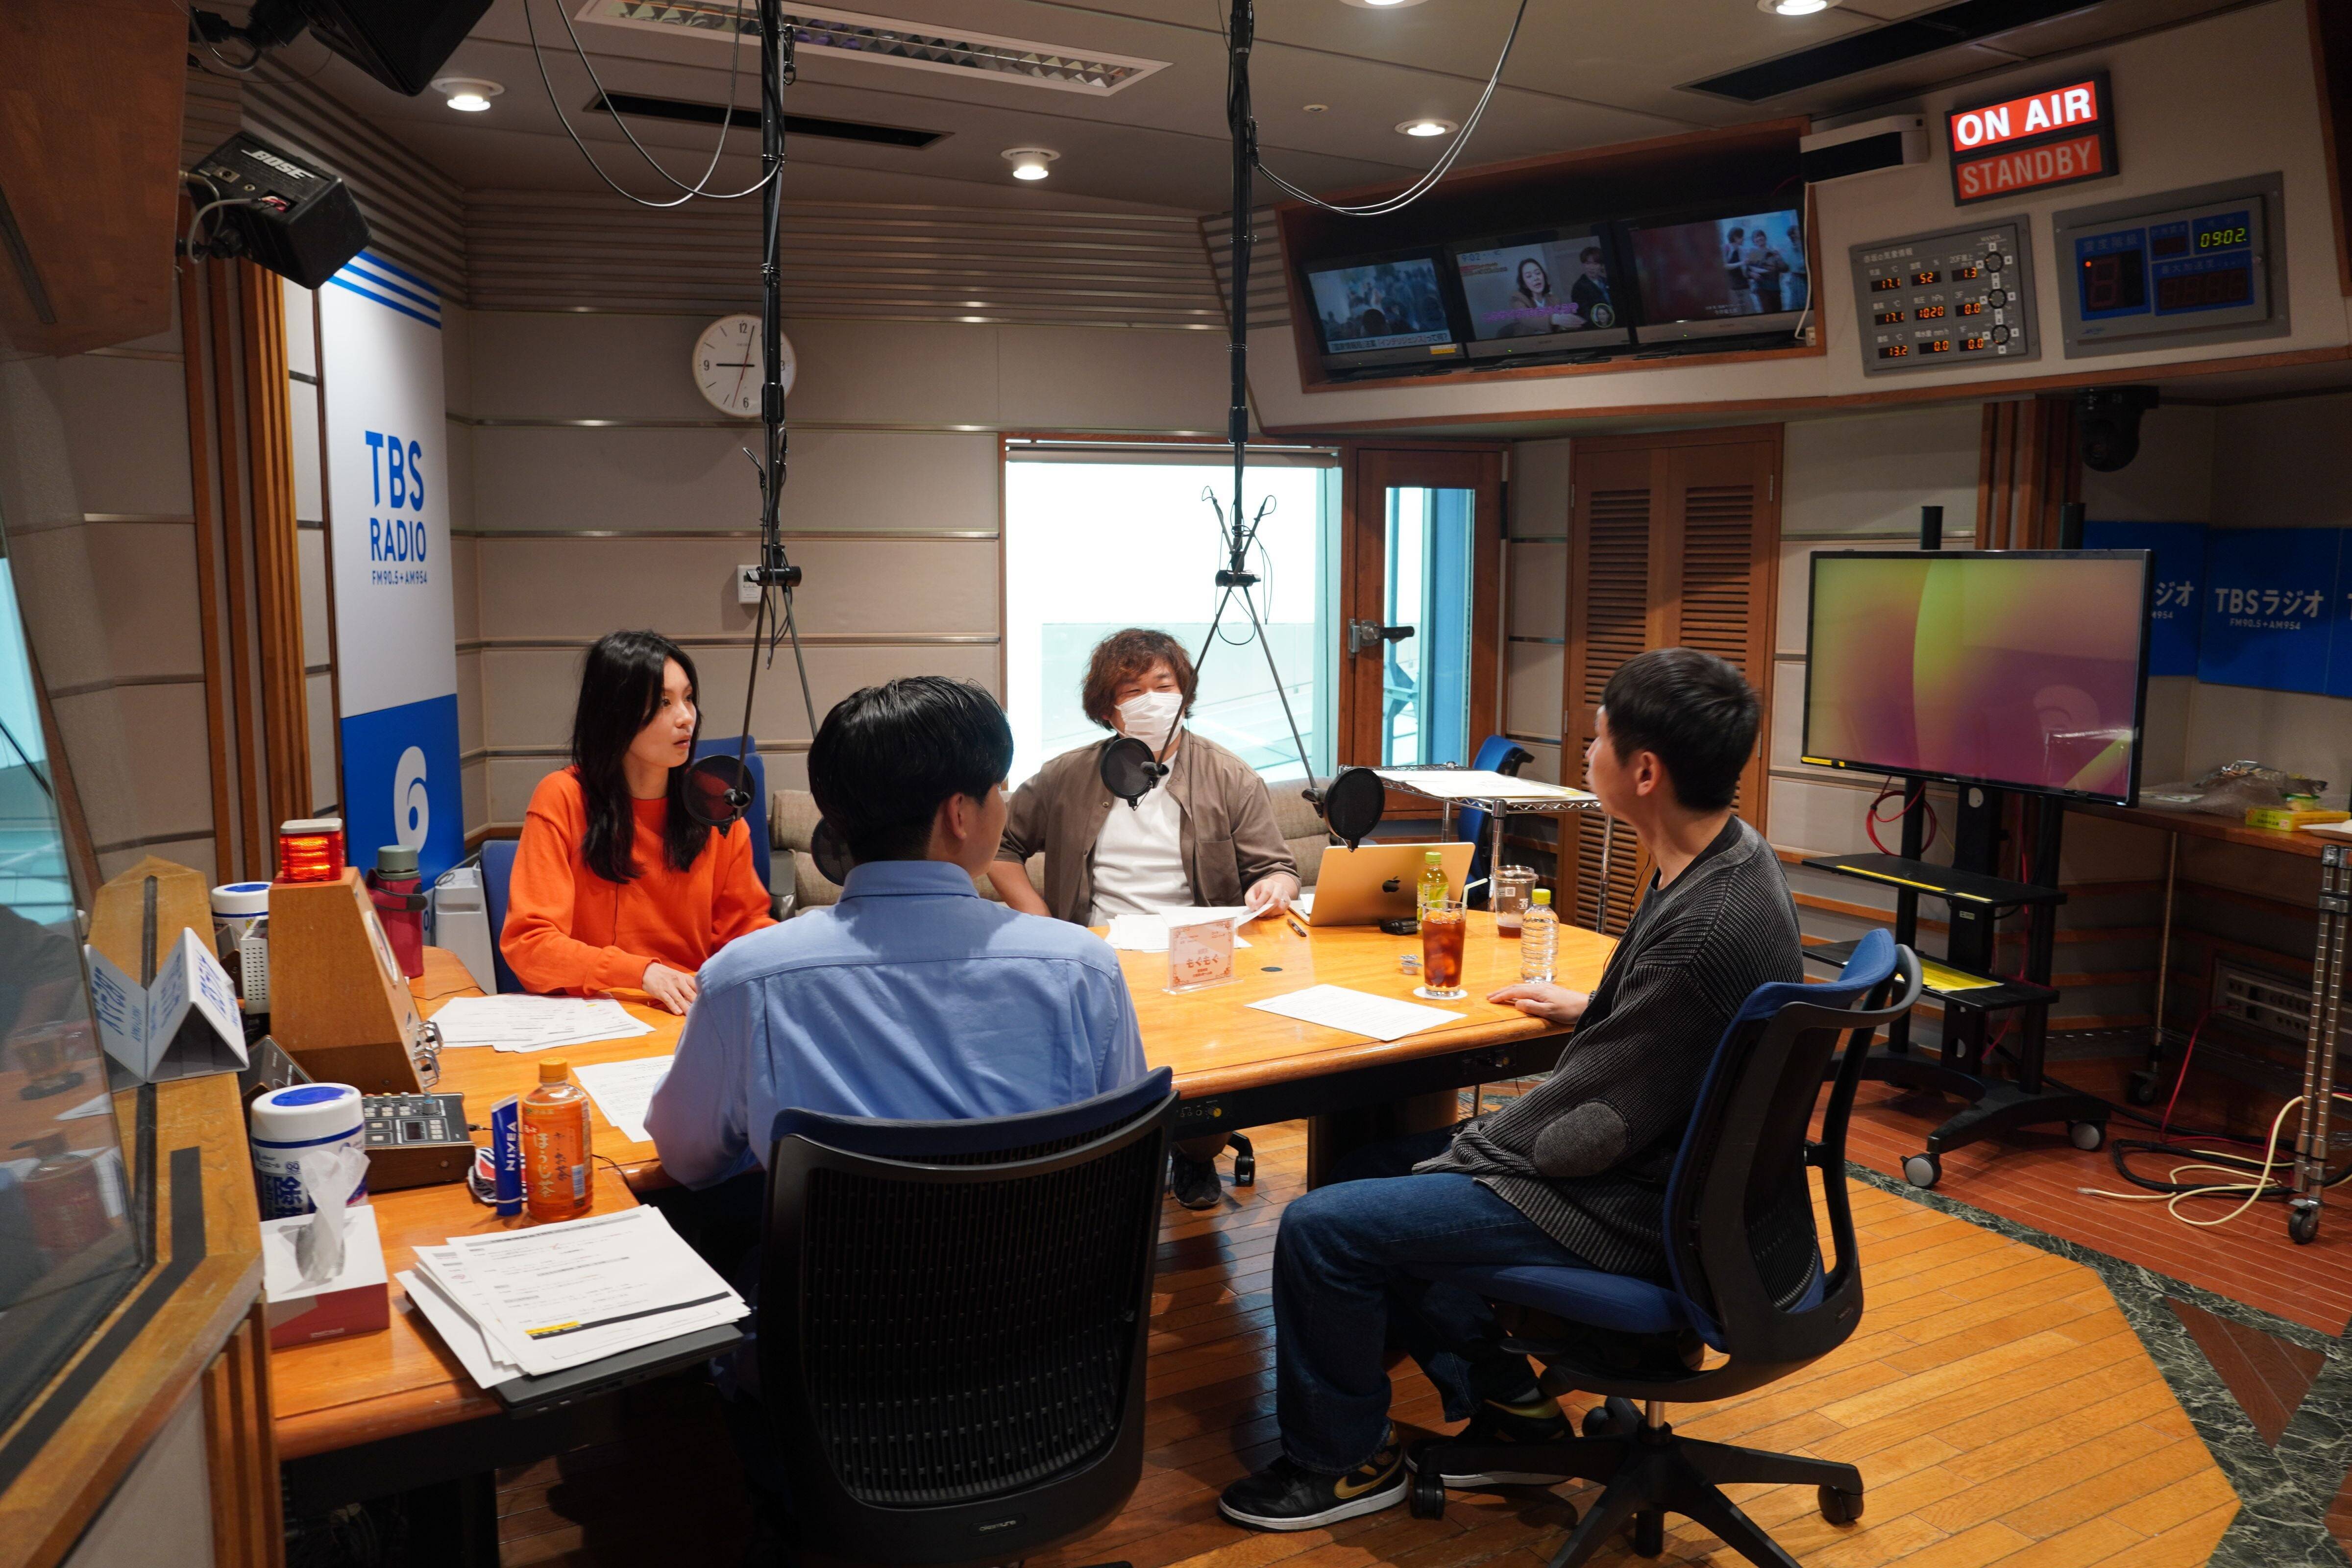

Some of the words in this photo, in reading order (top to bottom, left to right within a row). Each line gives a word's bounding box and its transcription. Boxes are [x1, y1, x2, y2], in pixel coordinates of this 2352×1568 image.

[1957, 107, 2010, 146] ON
[2025, 88, 2092, 132] AIR
[241, 149, 315, 179] BOSE
[1962, 141, 2092, 194] STANDBY
[1919, 272, 1935, 284] 52
[1963, 267, 1978, 278] 1.3
[1881, 277, 1901, 289] 17.1
[1918, 305, 1945, 319] 1020
[1964, 302, 1981, 315] 0.0
[1885, 311, 1905, 323] 17.1
[739, 322, 747, 334] 12
[1888, 344, 1909, 357] 13.2
[1933, 340, 1950, 352] 0.0
[1967, 338, 1984, 350] 0.0
[703, 360, 710, 371] 9
[743, 397, 749, 409] 6
[365, 430, 424, 512] TBS
[370, 517, 426, 562] RADIO
[2215, 588, 2324, 618] TBSラジオ
[1186, 954, 1219, 968] もぐもぐ
[505, 1121, 518, 1171] NIVEA
[533, 1133, 556, 1198] ほうじ茶
